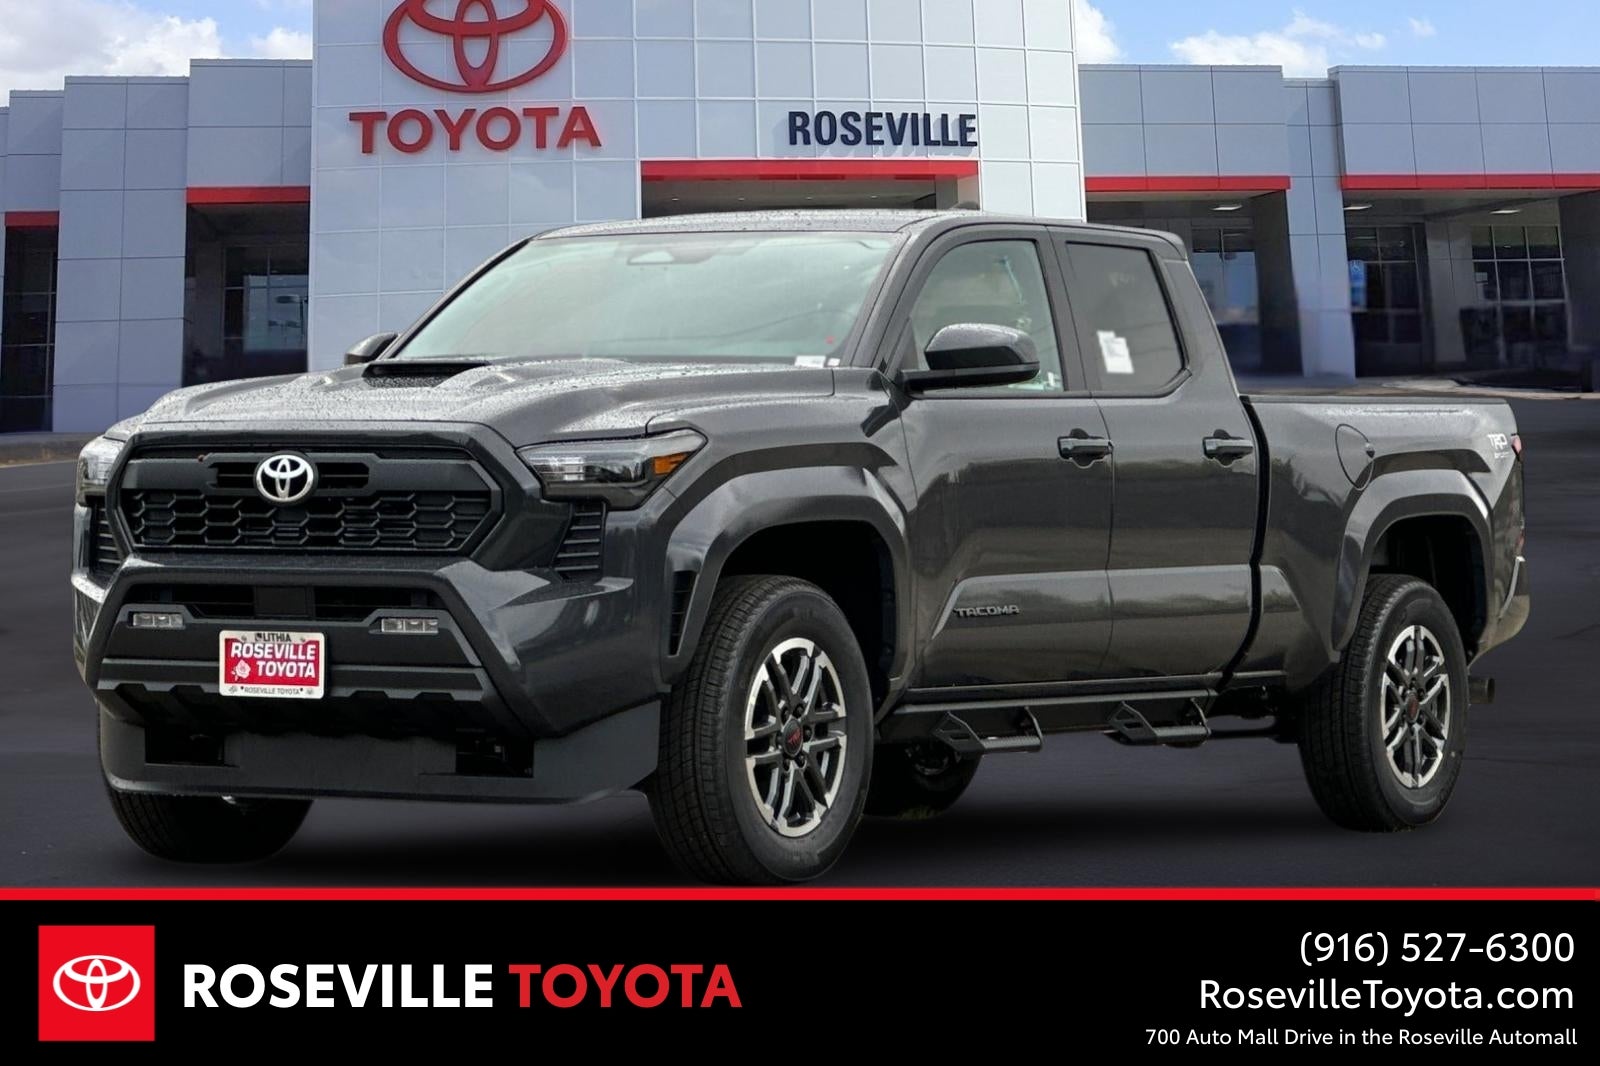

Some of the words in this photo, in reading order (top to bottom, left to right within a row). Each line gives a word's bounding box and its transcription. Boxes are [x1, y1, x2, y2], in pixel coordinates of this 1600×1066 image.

[349, 106, 602, 153] TOYOTA
[788, 110, 978, 147] ROSEVILLE
[953, 604, 1020, 617] TACOMA
[230, 642, 317, 660] ROSEVILLE
[256, 660, 316, 678] TOYOTA
